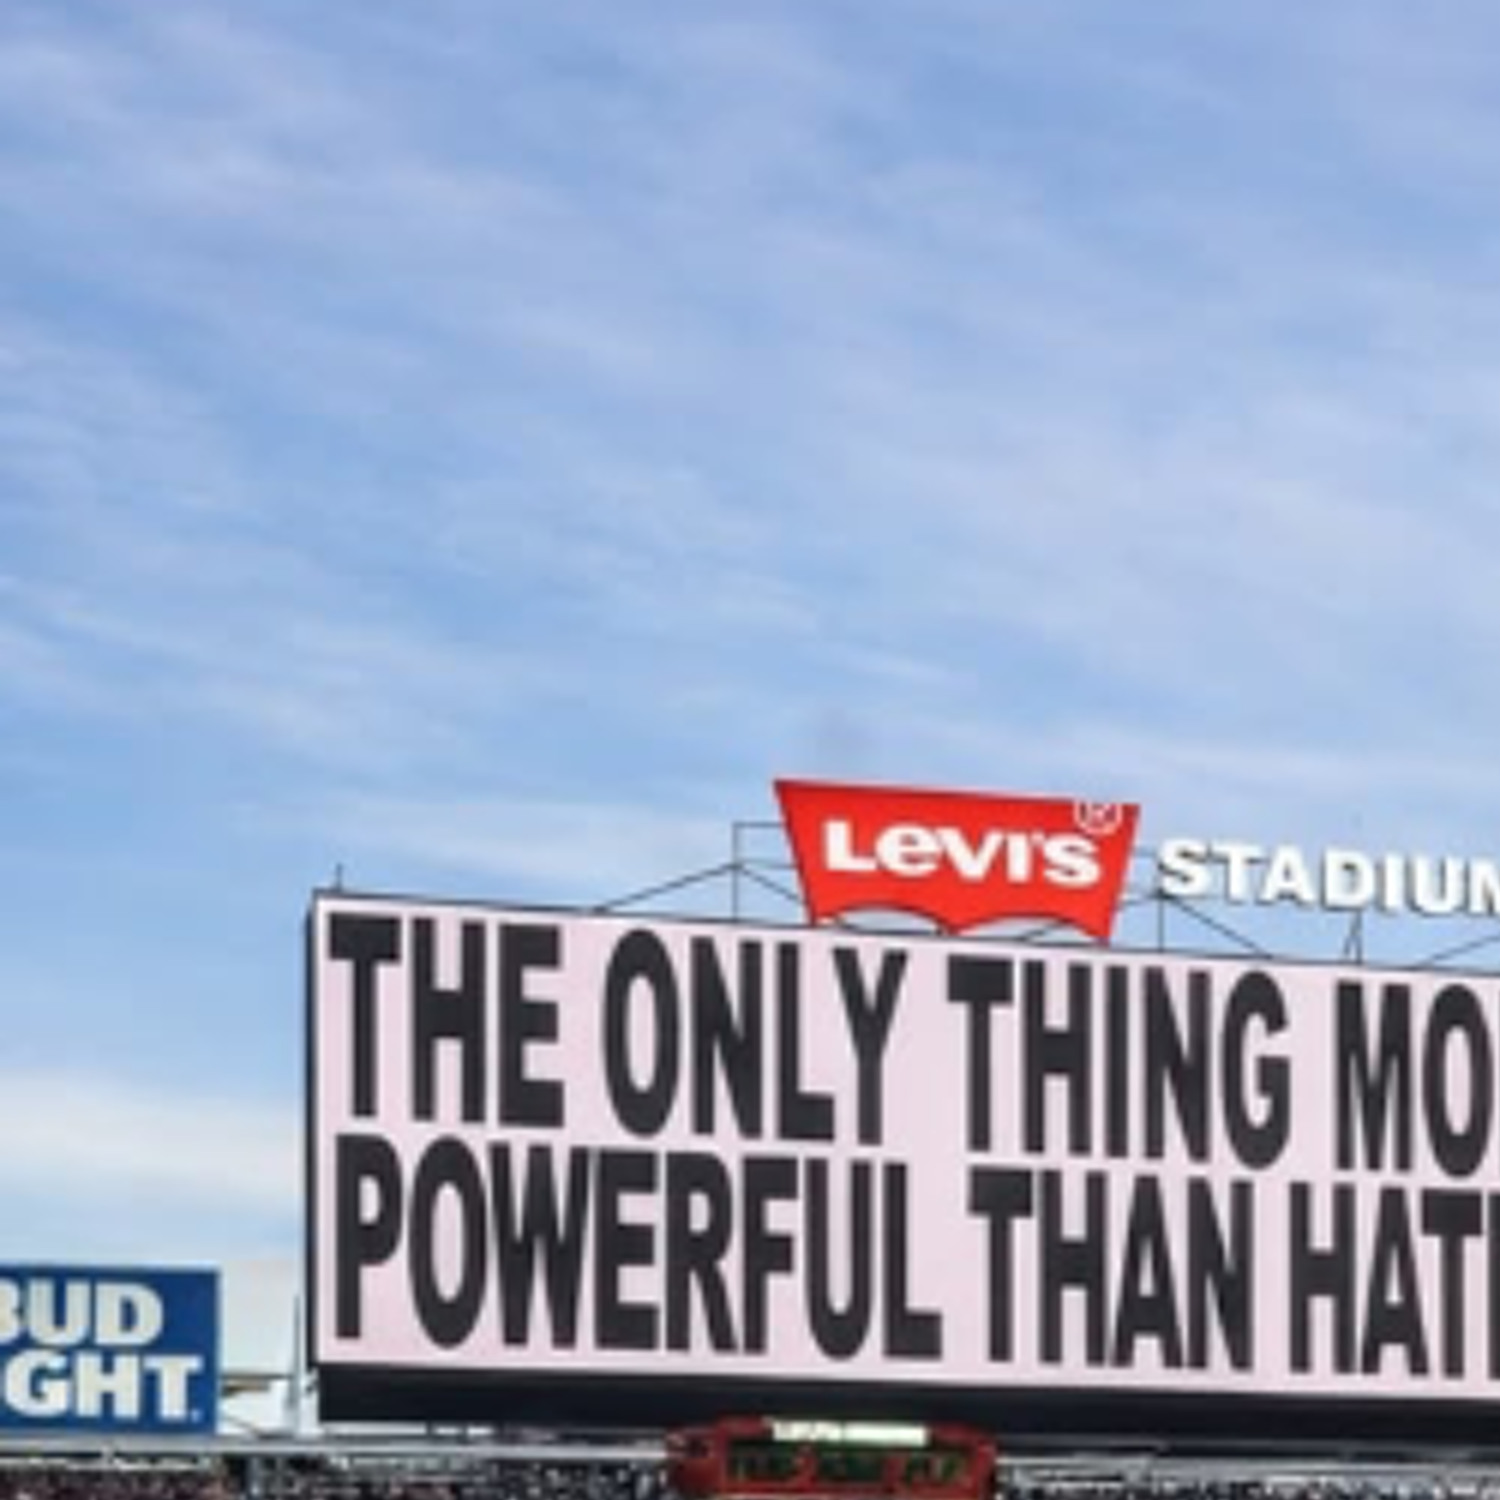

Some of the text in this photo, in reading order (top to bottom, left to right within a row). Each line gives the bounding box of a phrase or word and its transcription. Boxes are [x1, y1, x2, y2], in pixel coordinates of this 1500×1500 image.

[329, 912, 565, 1130] THE
[604, 928, 909, 1147] ONLY
[947, 954, 1291, 1170] THING
[335, 1133, 944, 1361] POWERFUL
[968, 1165, 1254, 1372] THAN
